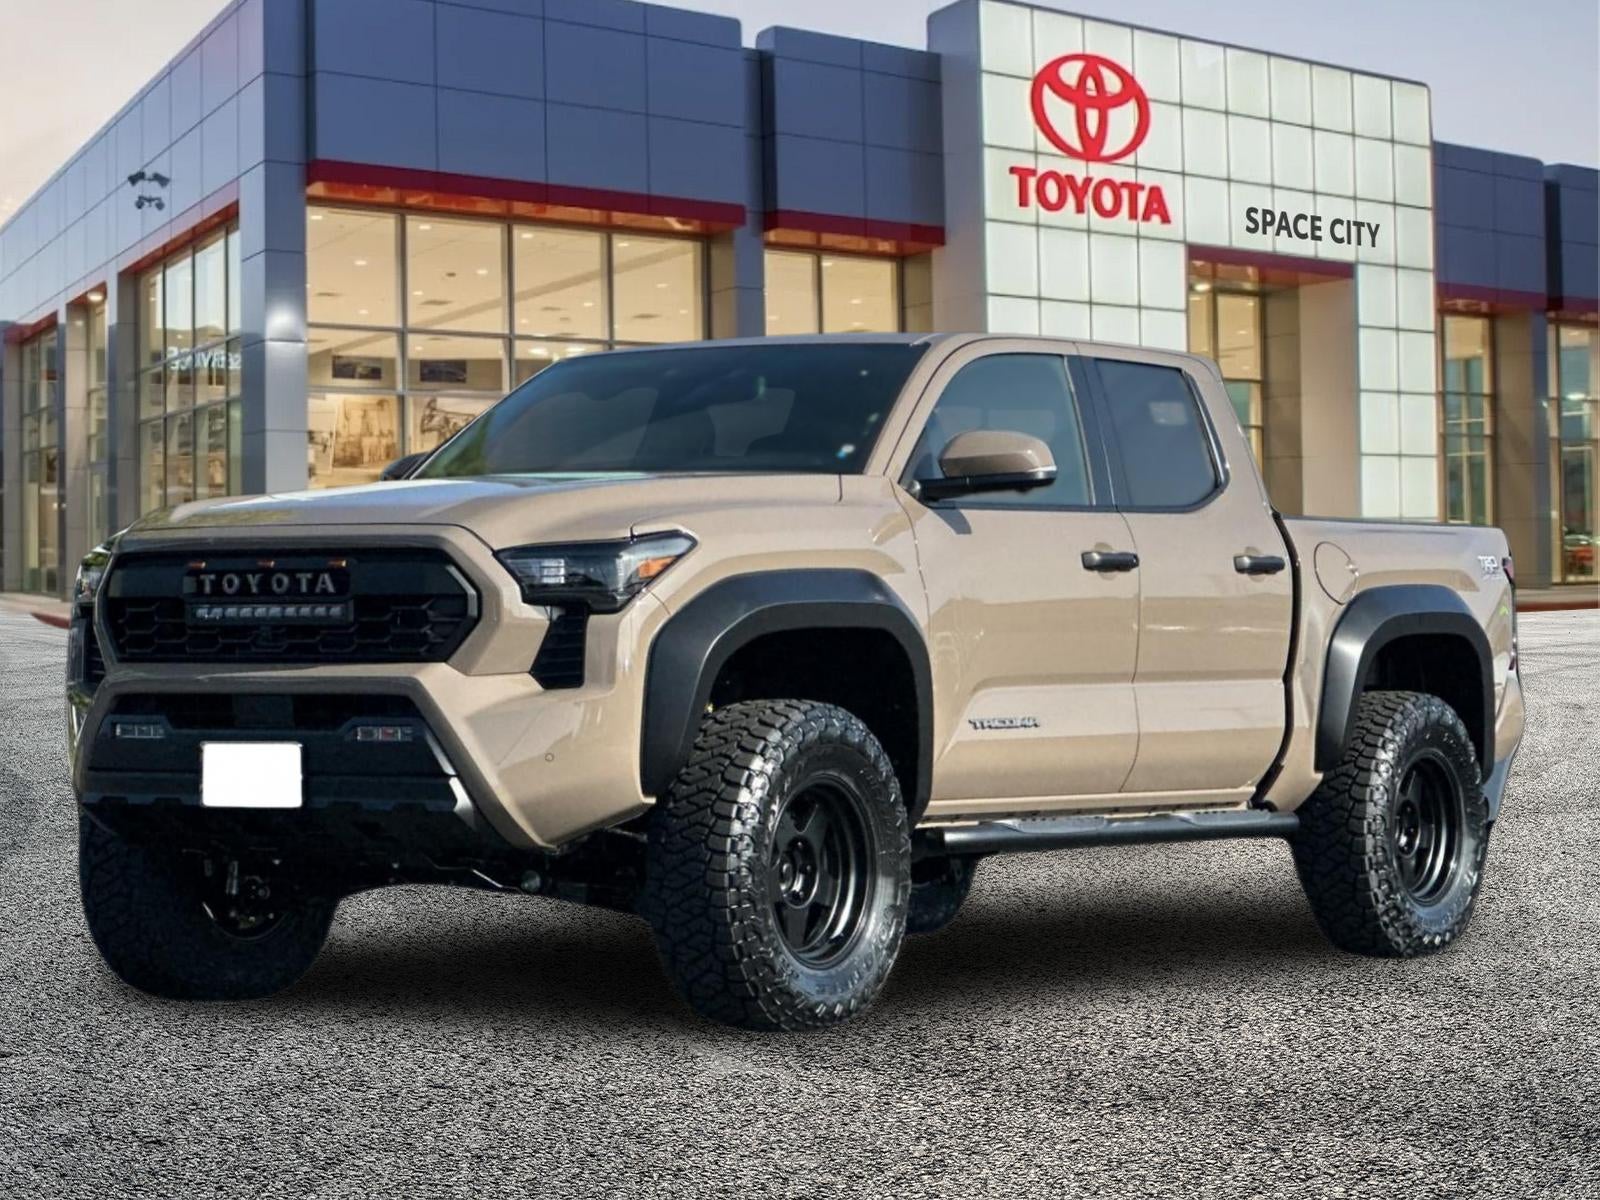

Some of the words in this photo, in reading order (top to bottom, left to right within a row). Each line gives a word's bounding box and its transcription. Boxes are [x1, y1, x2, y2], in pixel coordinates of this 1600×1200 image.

[1009, 166, 1171, 225] TOYOTA
[1245, 206, 1322, 241] SPACE
[1329, 218, 1381, 248] CITY
[199, 572, 337, 595] TOYOTA
